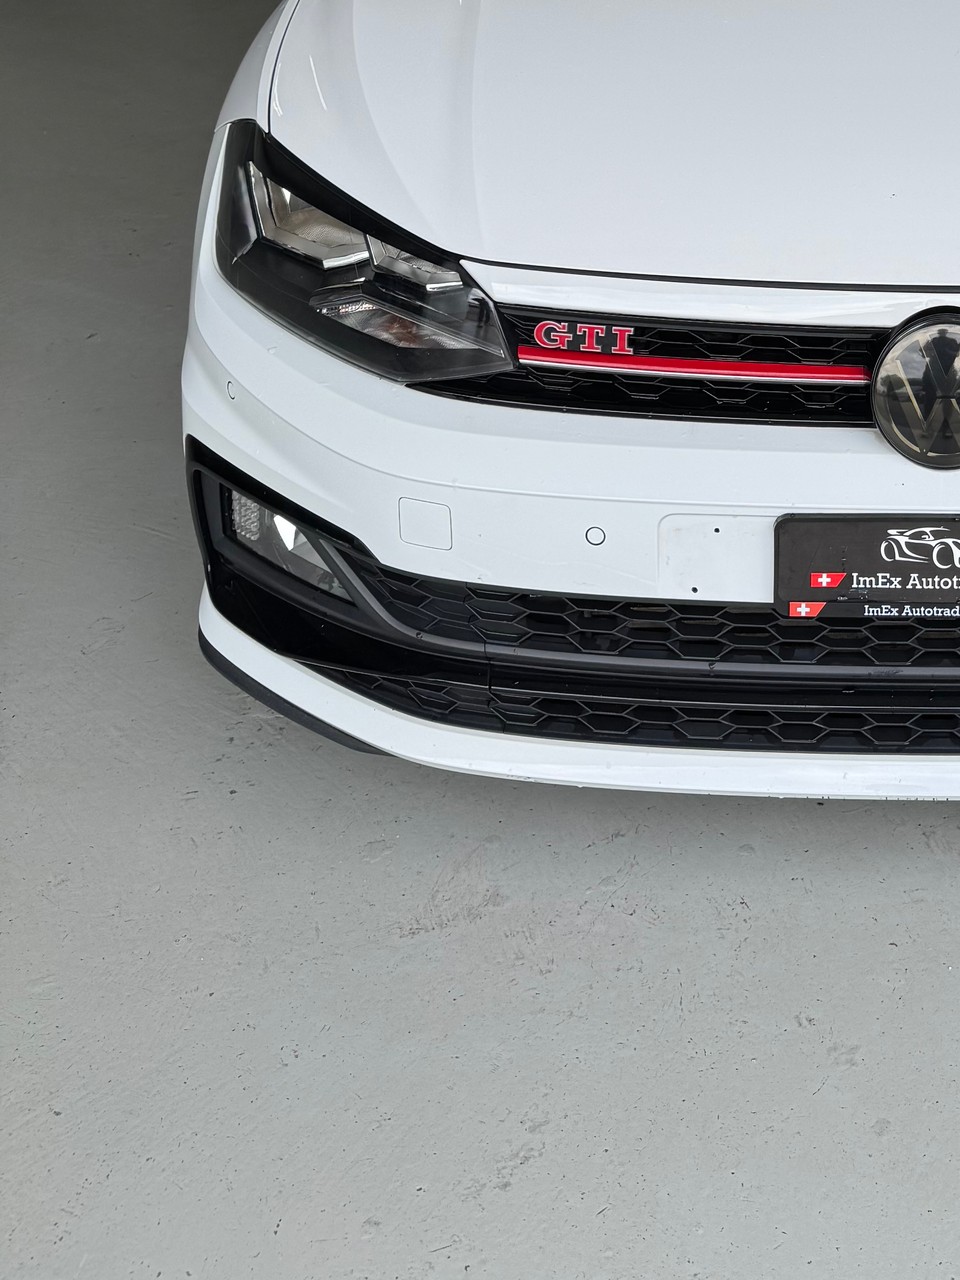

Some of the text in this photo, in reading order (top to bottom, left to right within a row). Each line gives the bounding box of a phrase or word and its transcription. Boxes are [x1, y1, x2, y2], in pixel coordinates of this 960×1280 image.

[533, 320, 635, 355] GTI
[851, 572, 902, 589] ImEx
[863, 604, 900, 617] ImEx
